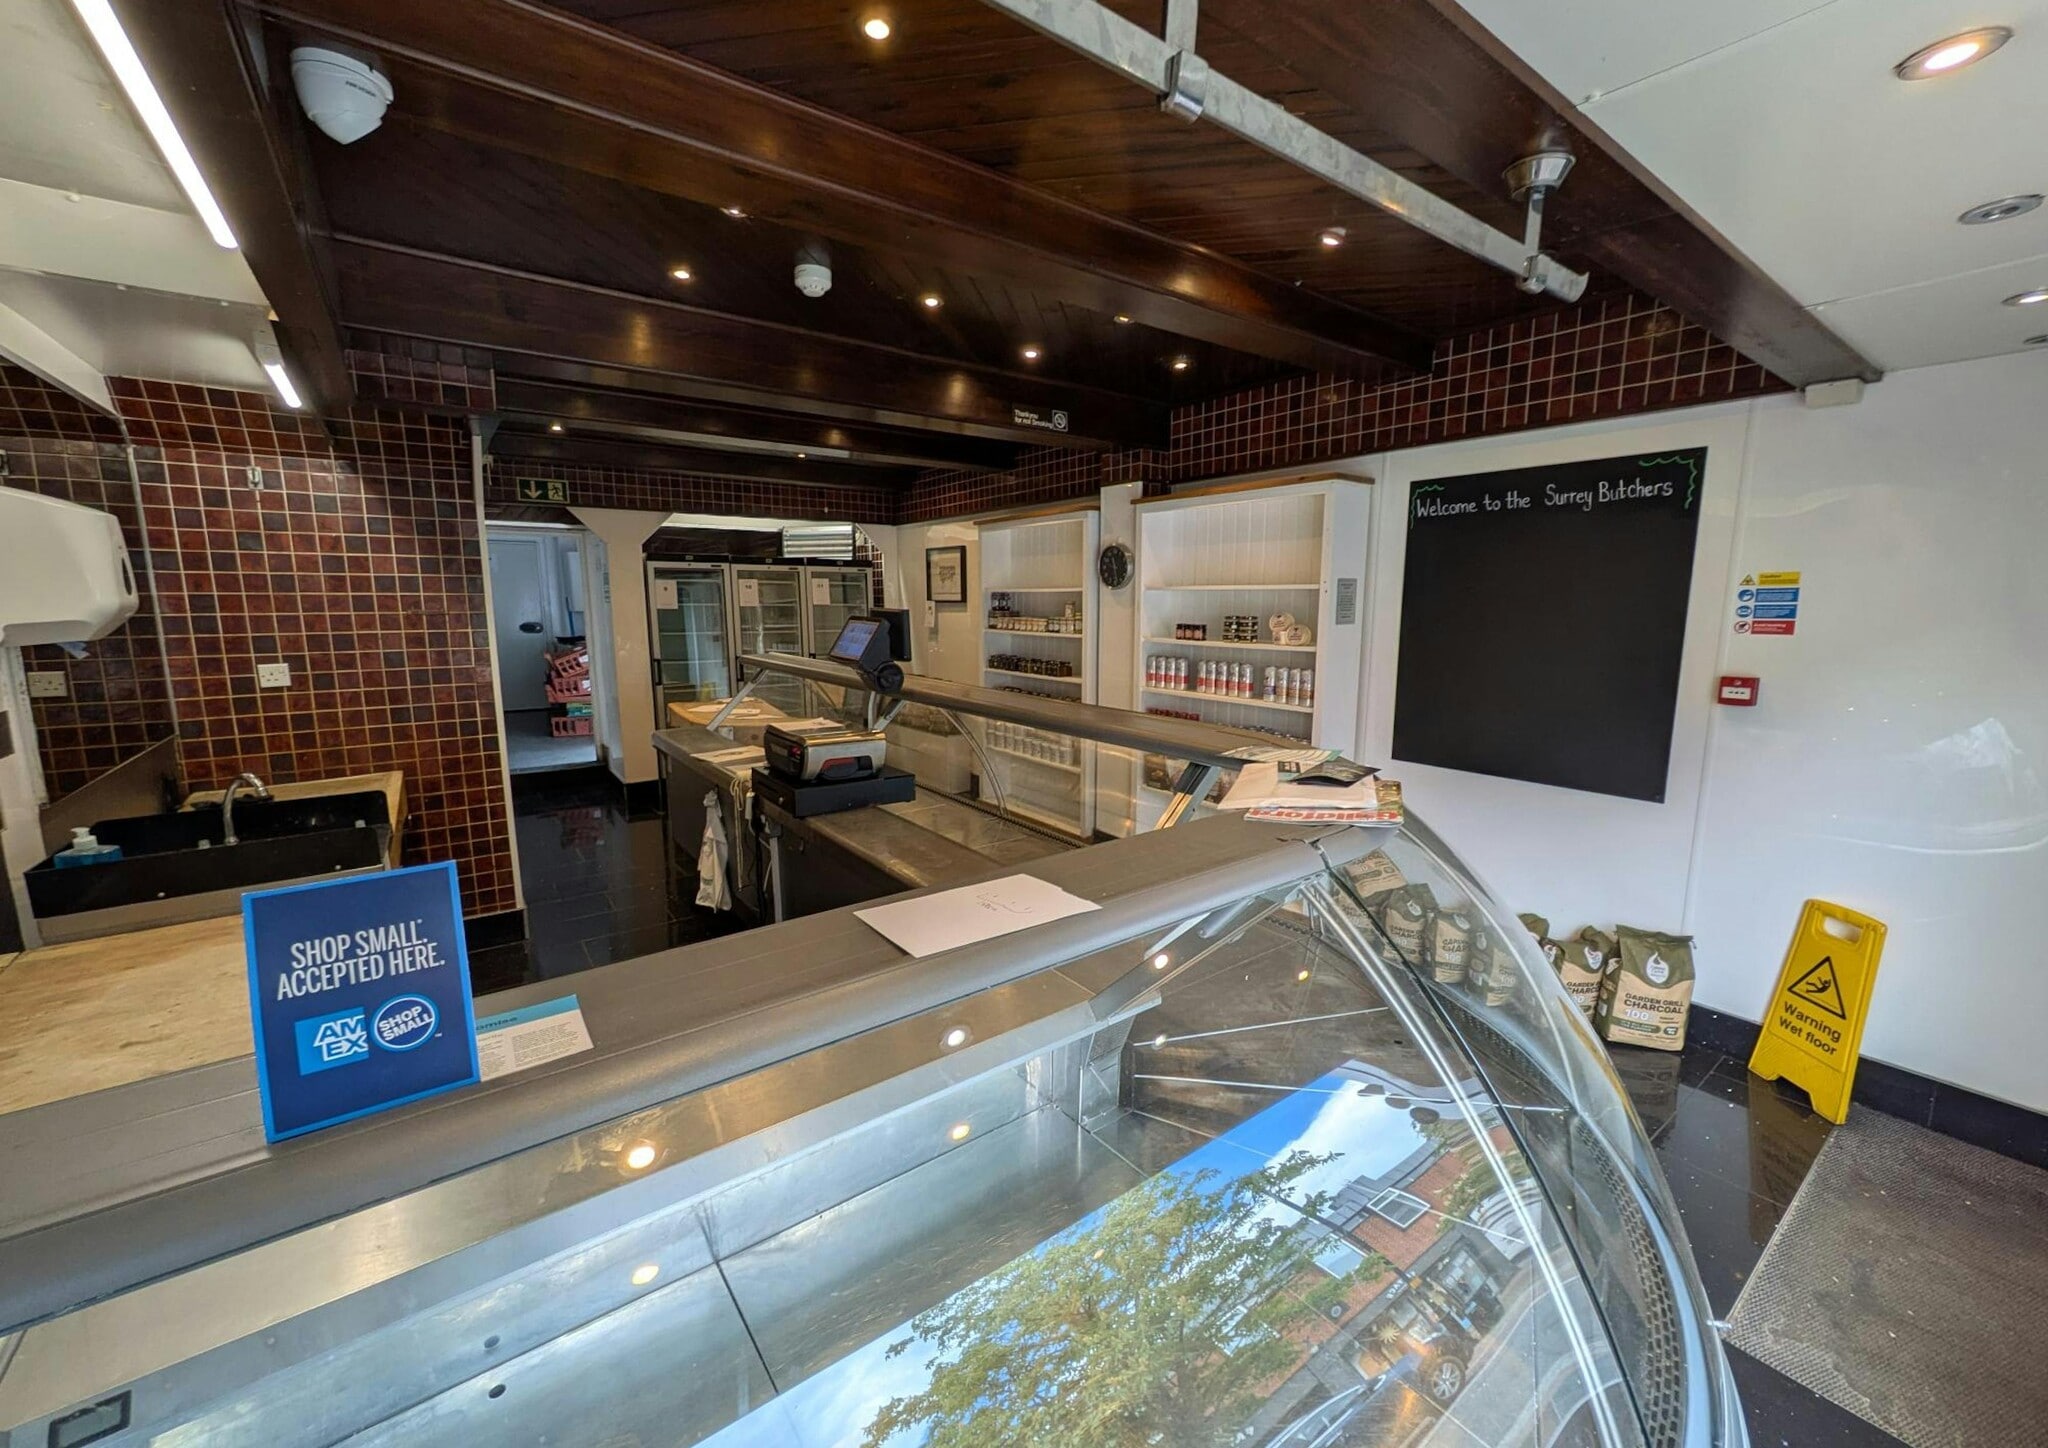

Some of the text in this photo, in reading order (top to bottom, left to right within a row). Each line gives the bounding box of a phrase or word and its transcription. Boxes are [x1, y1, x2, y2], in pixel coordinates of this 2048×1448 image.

[1415, 477, 1674, 518] Welcome to the Surrey Butchers
[290, 933, 350, 969] SHOP
[277, 942, 445, 1000] ACCEPTED HERE.
[1624, 999, 1683, 1015] CHARCOAL
[1625, 993, 1661, 1005] GARDEN
[378, 1005, 423, 1032] SHOP
[381, 1012, 434, 1042] SMALL
[1779, 1015, 1838, 1057] Wet floor
[1783, 1000, 1842, 1043] Warning
